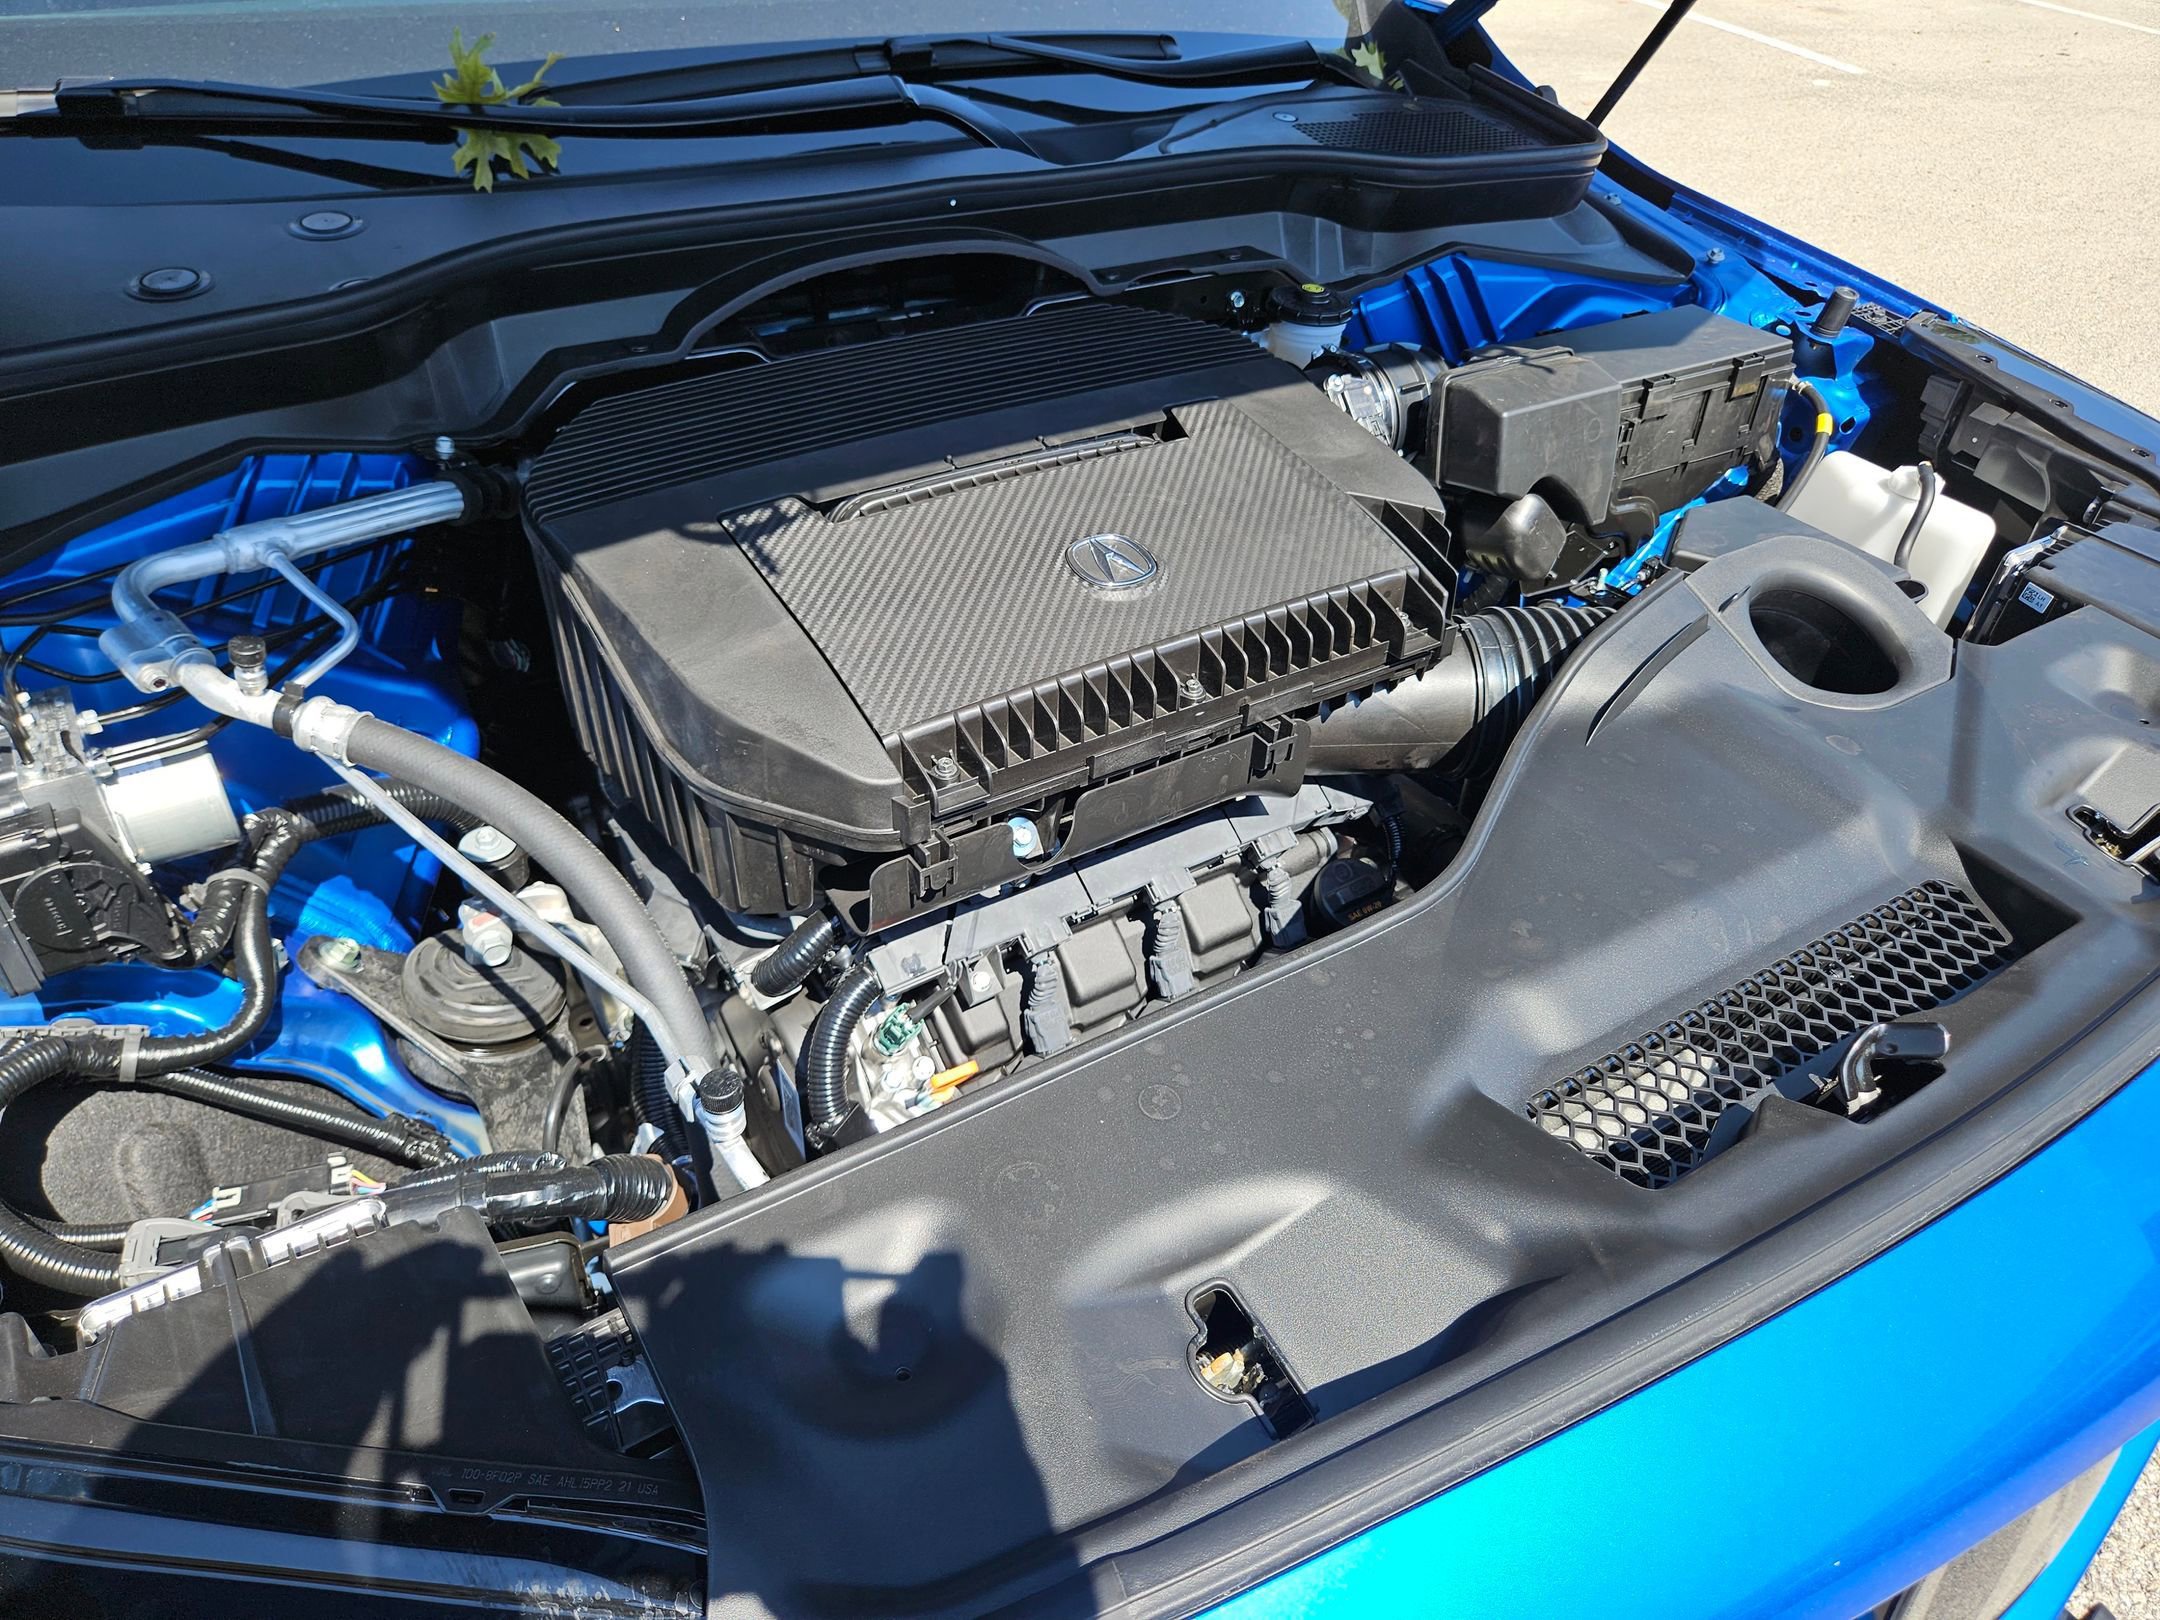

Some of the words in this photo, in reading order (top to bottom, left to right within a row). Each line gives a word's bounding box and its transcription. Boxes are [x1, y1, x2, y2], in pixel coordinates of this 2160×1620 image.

[527, 1473, 552, 1487] SAE
[618, 1480, 632, 1493] 21
[637, 1483, 659, 1496] USA
